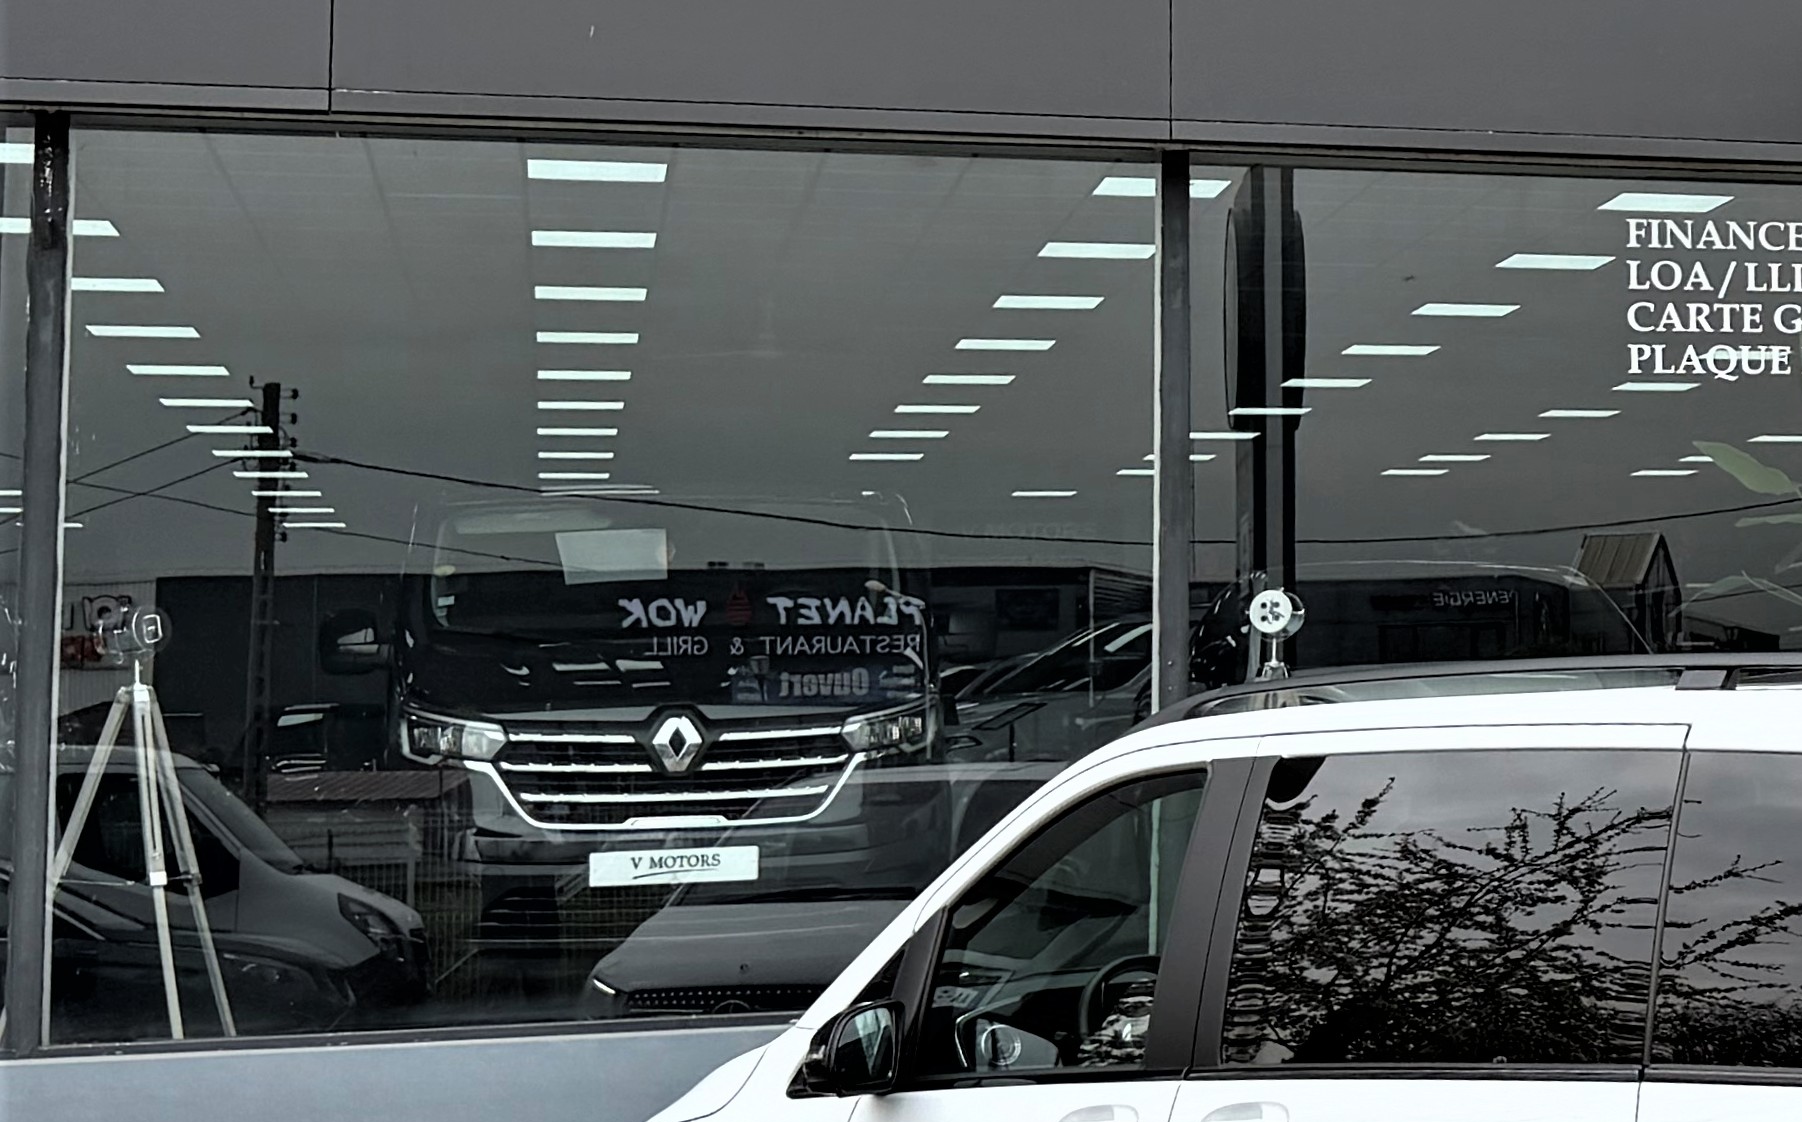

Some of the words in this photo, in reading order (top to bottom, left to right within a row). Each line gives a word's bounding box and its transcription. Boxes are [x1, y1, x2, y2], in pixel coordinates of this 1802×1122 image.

[1626, 301, 1763, 333] CARTE
[1626, 344, 1792, 381] PLAQUE
[630, 856, 643, 870] V
[649, 853, 721, 869] MOTORS
